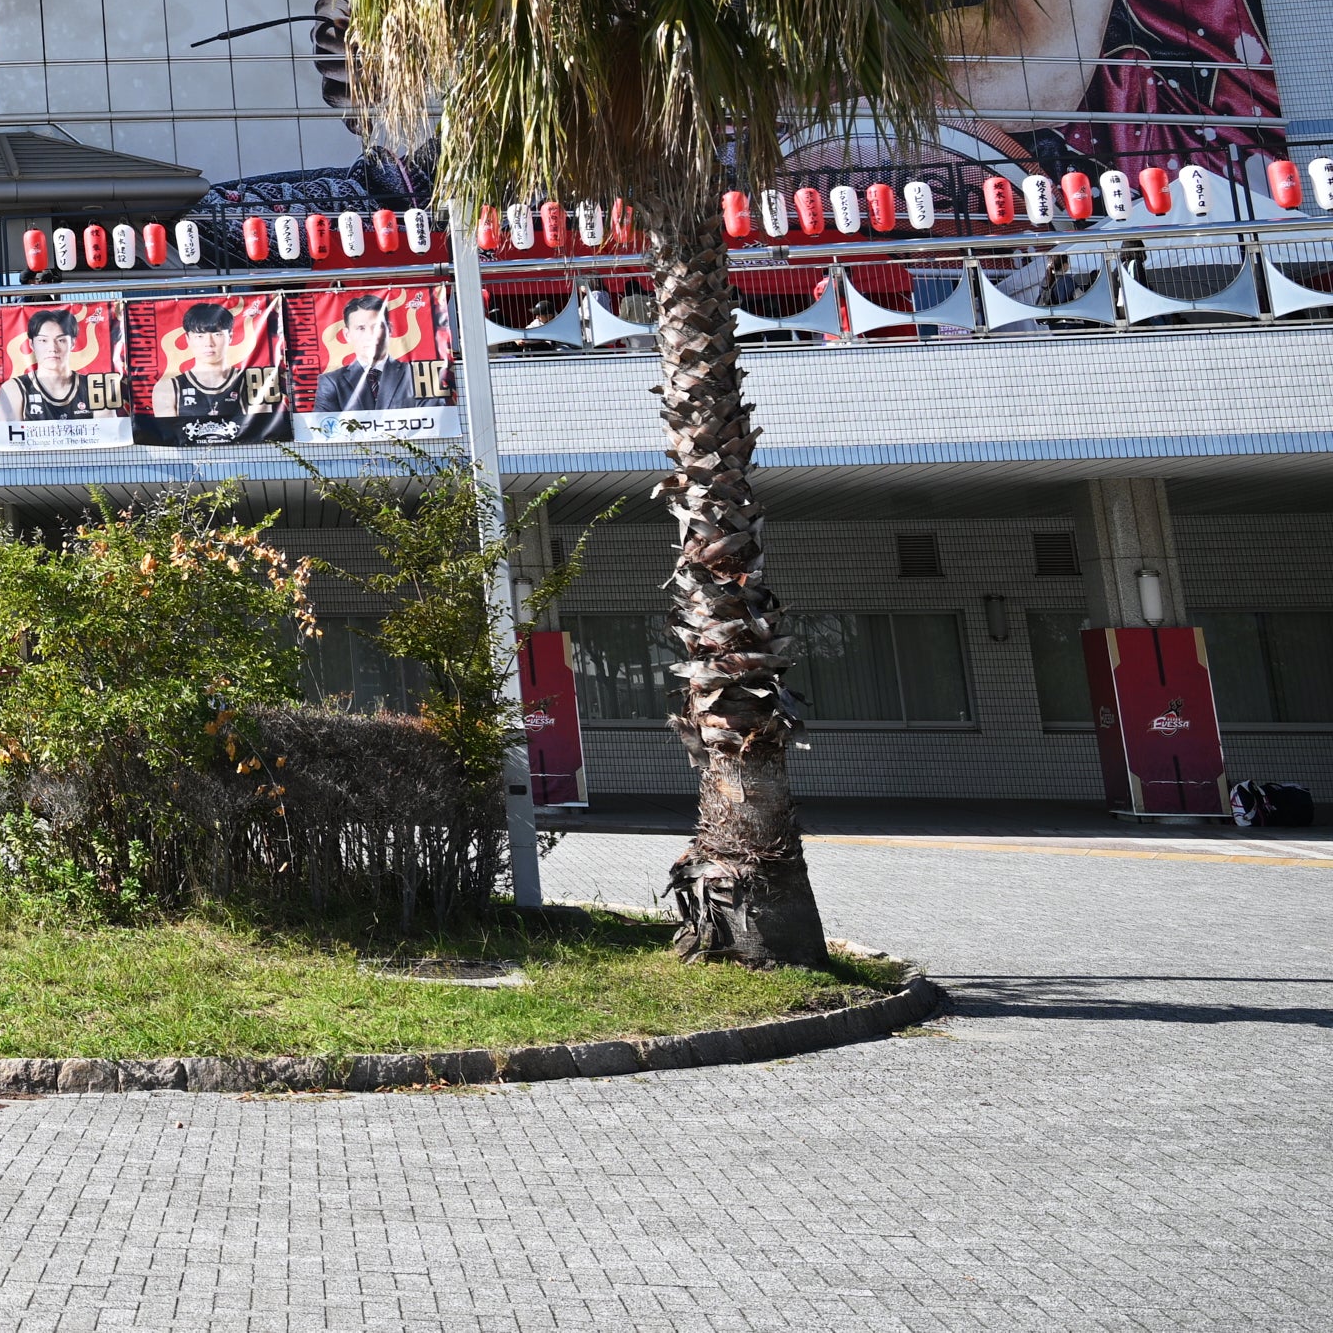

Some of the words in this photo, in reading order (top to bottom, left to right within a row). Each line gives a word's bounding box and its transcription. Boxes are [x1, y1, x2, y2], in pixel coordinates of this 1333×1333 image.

[86, 372, 123, 410] 60
[359, 416, 434, 433] マトエスロン
[1151, 716, 1190, 730] EVESSA
